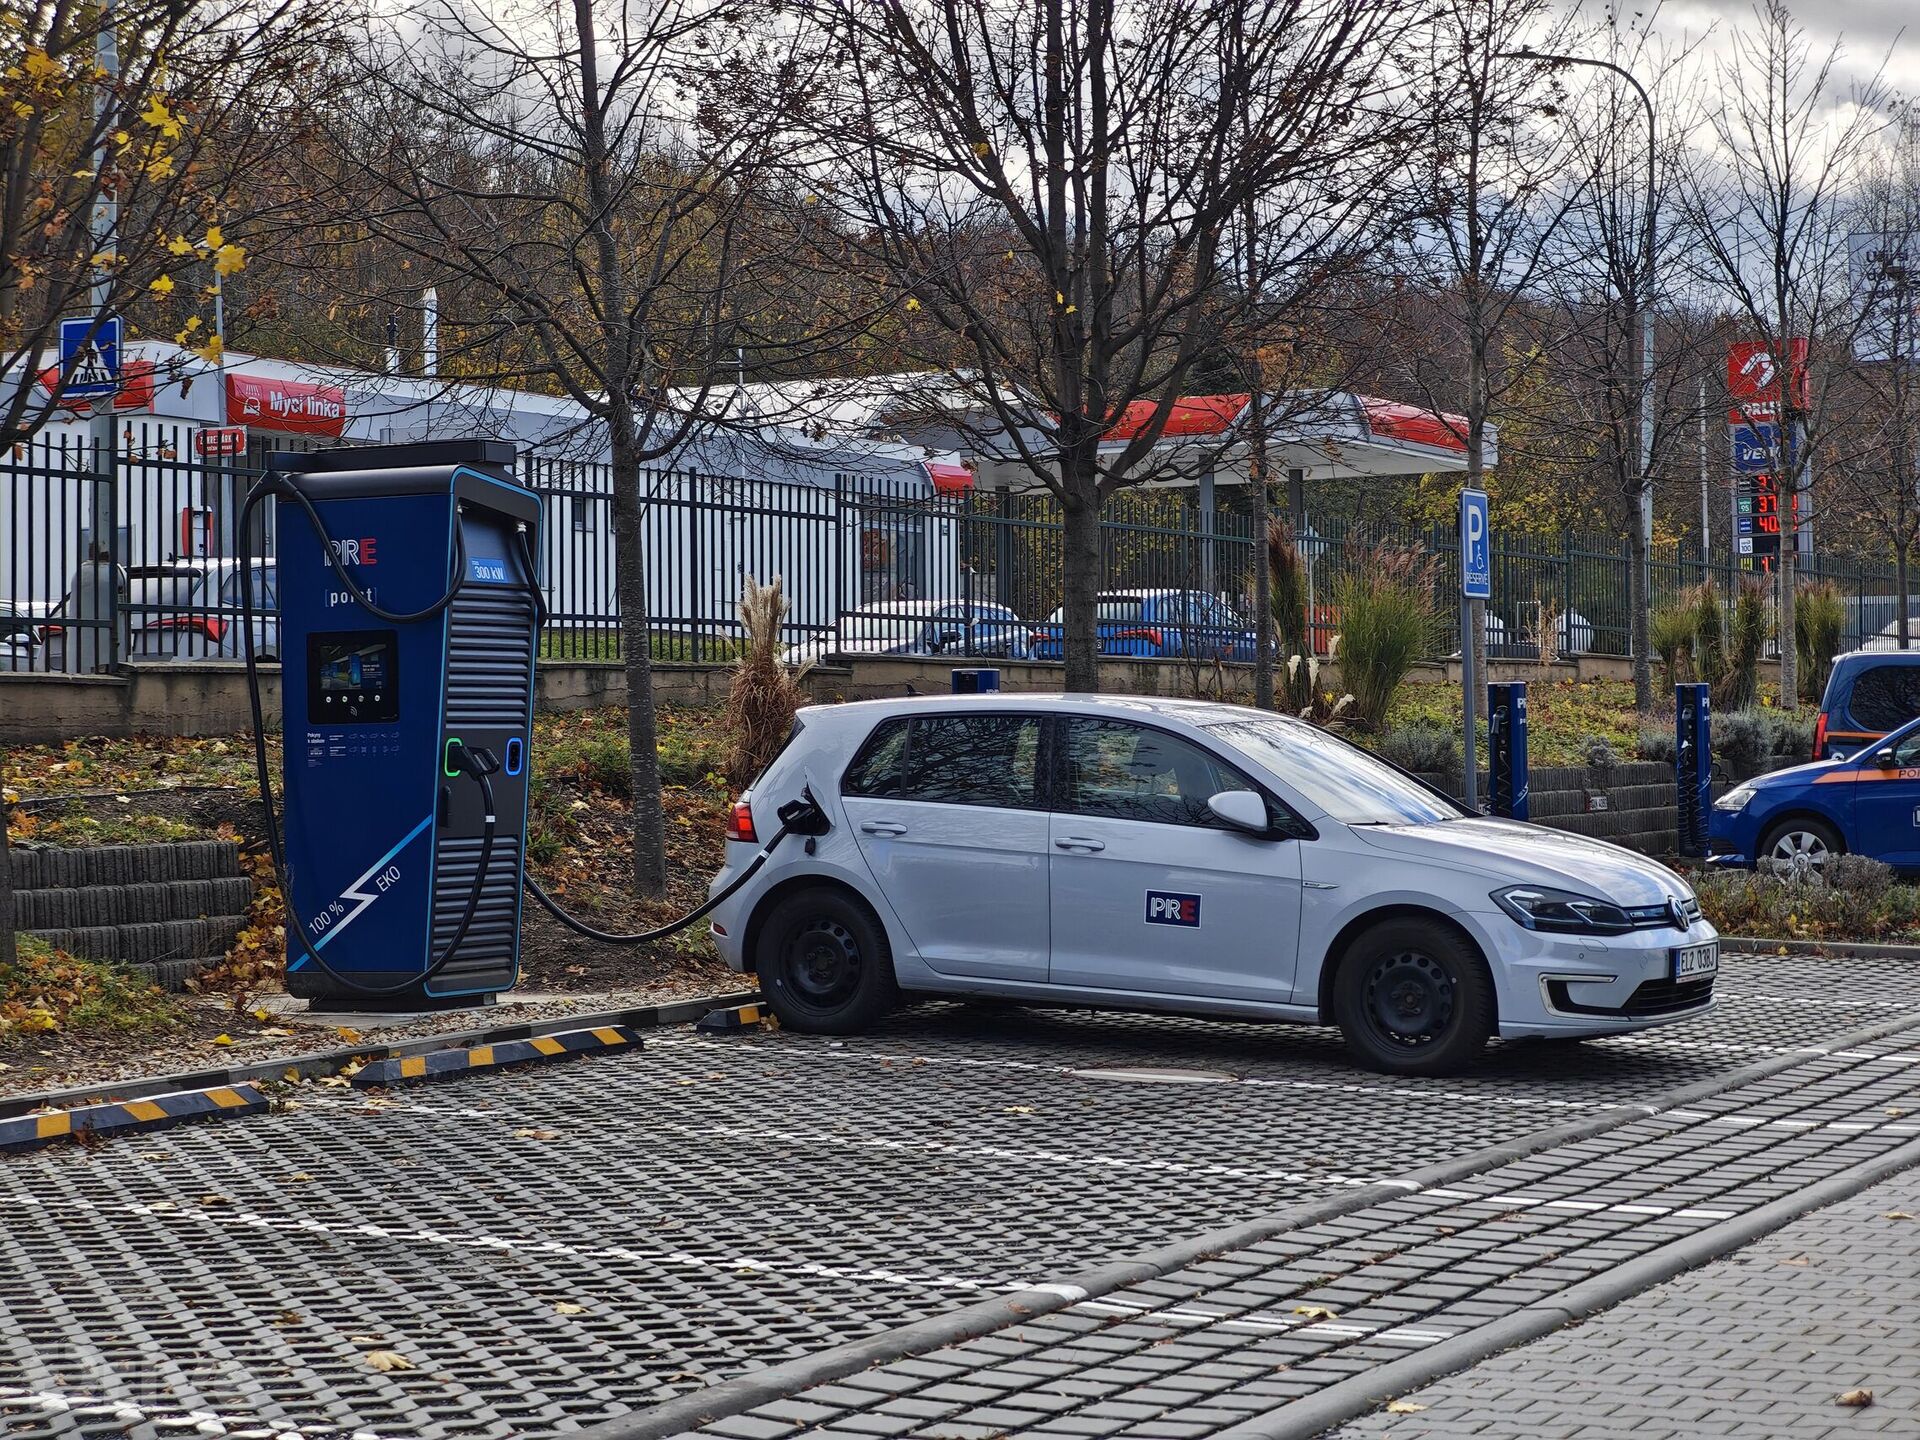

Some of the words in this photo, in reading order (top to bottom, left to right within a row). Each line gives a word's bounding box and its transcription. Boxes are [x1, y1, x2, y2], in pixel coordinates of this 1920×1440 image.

[306, 395, 341, 418] linka
[1468, 504, 1483, 563] P
[324, 539, 377, 567] PRE
[474, 565, 490, 579] 300
[491, 567, 504, 580] kW
[309, 911, 331, 934] 100
[329, 901, 345, 916] %
[375, 865, 401, 892] EKO
[1150, 897, 1197, 922] PRE
[1681, 951, 1694, 972] EL2
